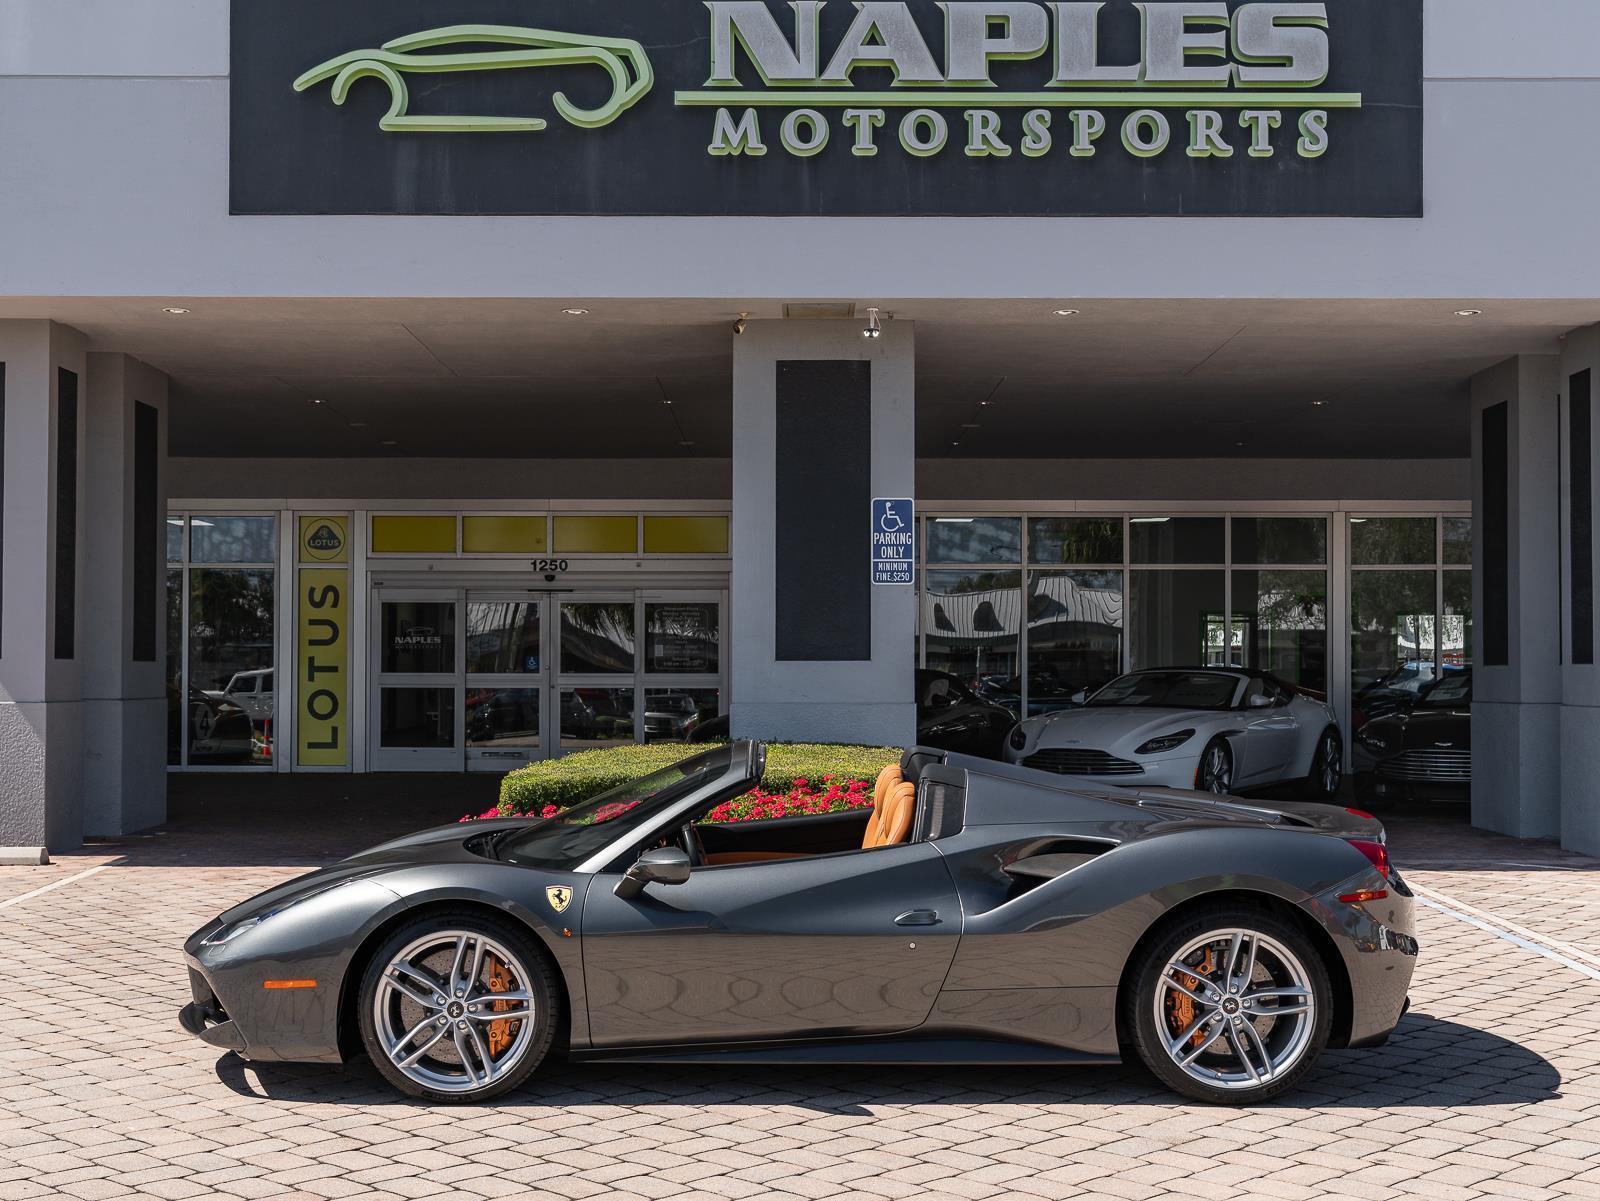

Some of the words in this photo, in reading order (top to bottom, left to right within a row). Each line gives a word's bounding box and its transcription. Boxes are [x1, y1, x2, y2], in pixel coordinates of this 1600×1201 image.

[703, 1, 1329, 87] NAPLES
[708, 108, 1329, 157] MOTORSPORTS
[310, 539, 340, 547] LOTUS
[873, 532, 912, 545] PARKING
[881, 546, 905, 558] ONLY
[530, 559, 568, 571] 1250
[878, 562, 908, 571] MINIMUM
[876, 572, 891, 581] FINE
[893, 572, 910, 582] $250
[394, 636, 442, 644] NAPLES
[307, 584, 340, 750] LOTUS
